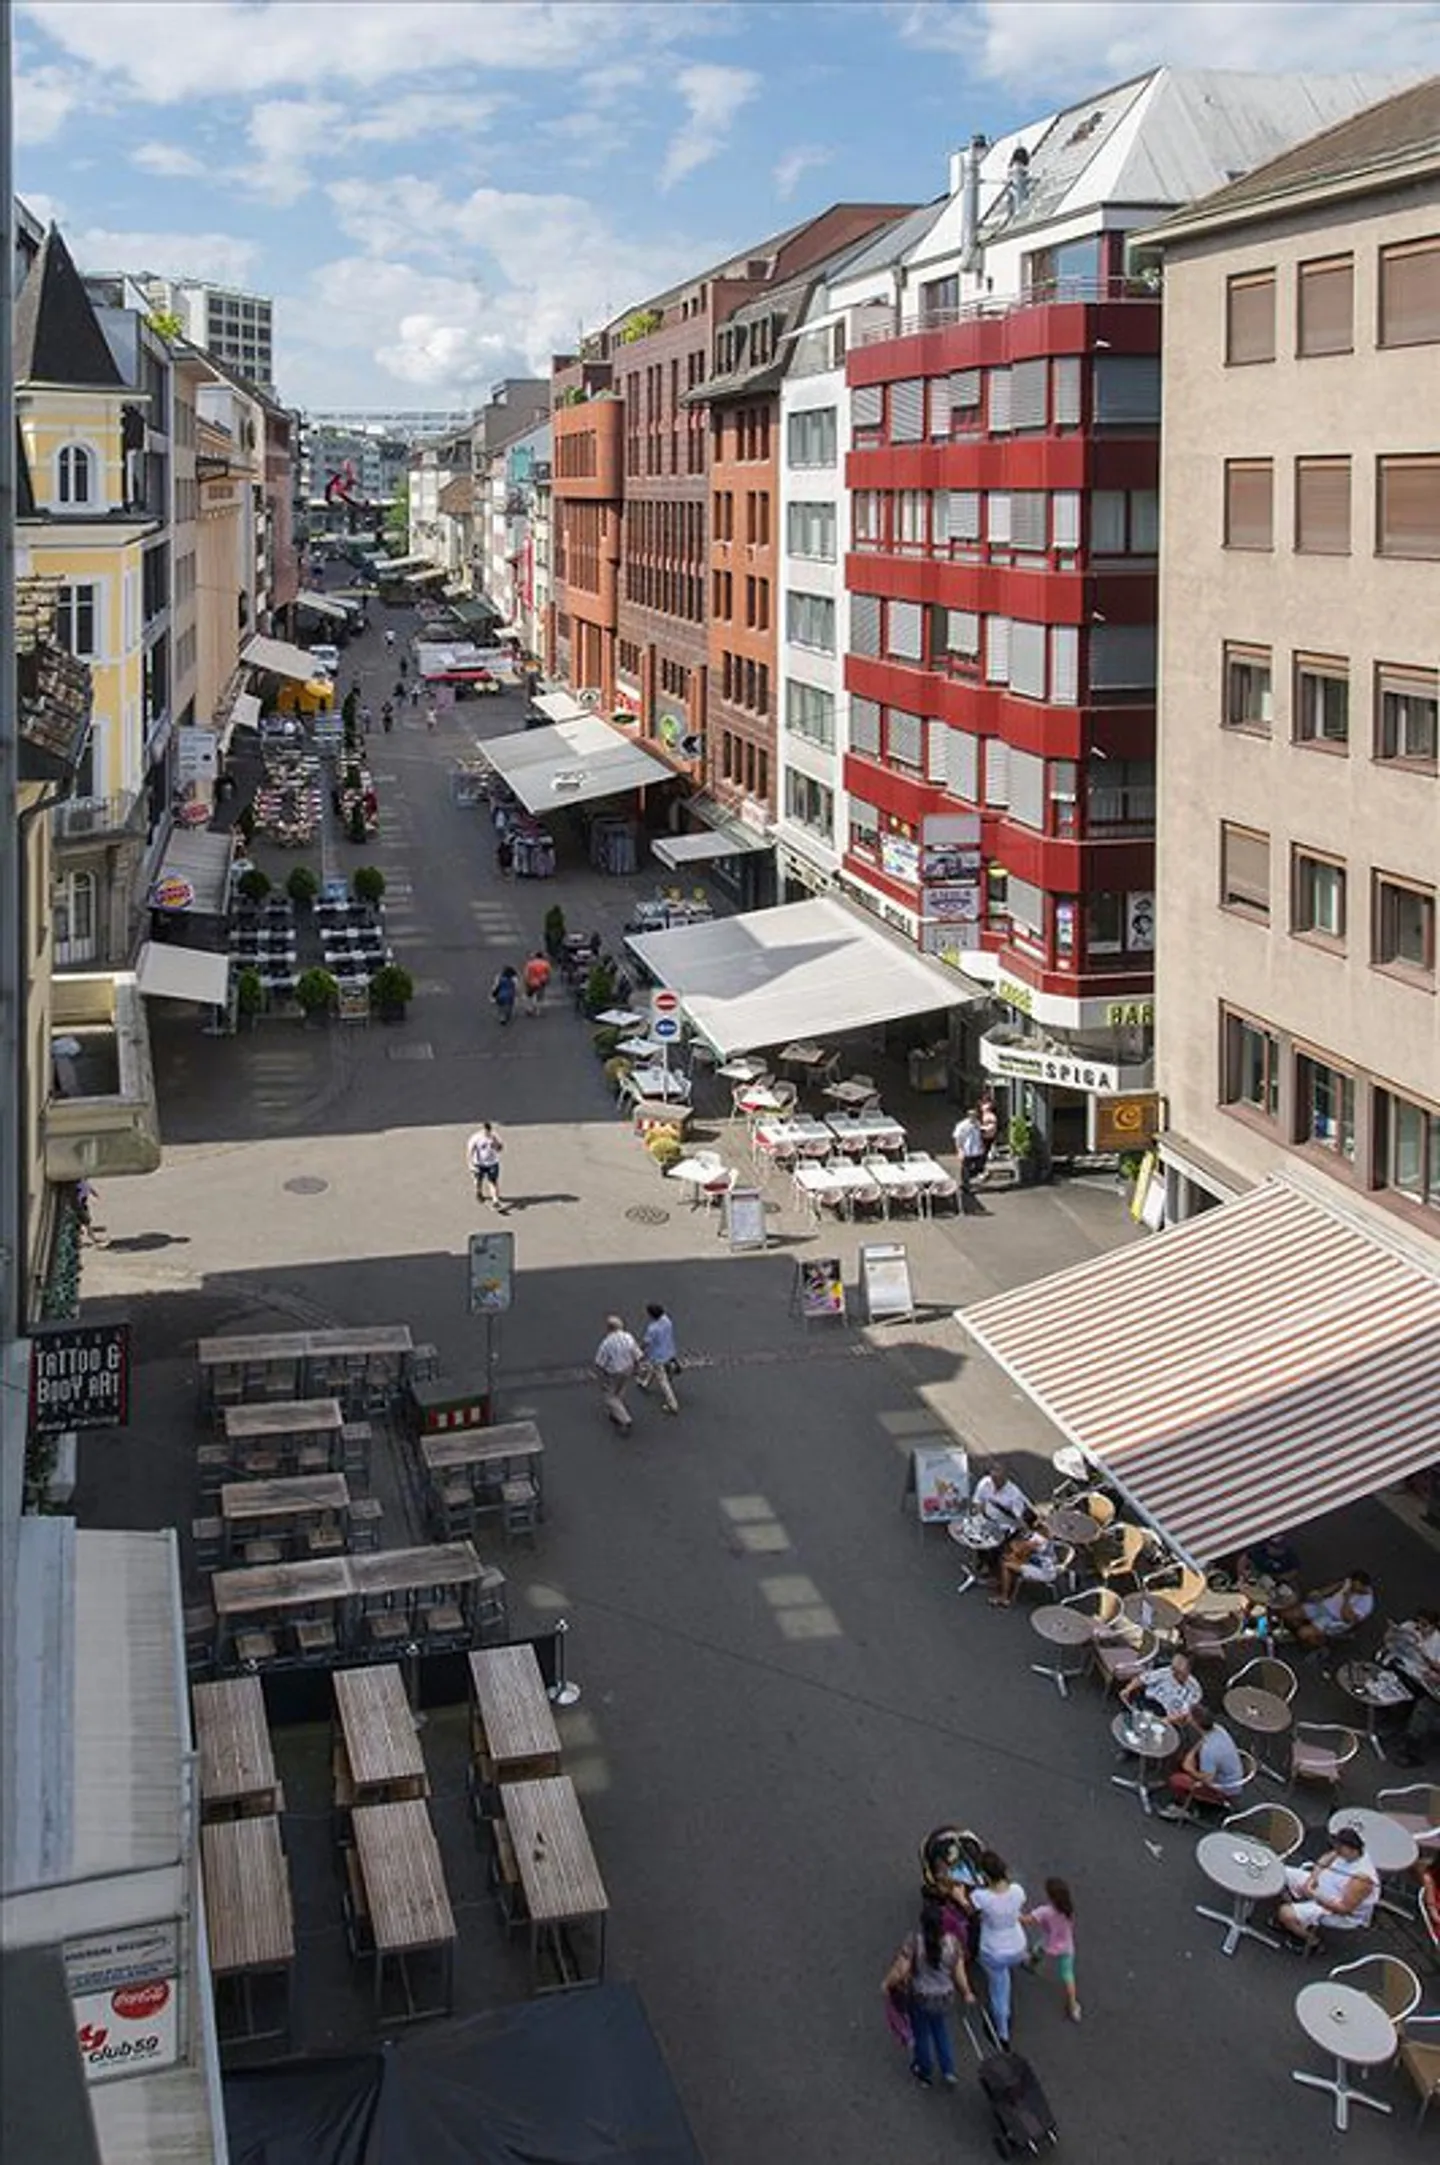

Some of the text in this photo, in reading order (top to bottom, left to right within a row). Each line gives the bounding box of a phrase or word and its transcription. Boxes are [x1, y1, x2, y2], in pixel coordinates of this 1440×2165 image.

[1107, 1003, 1154, 1027] BAR
[1045, 1060, 1110, 1090] SPIGA
[36, 1347, 102, 1377] TATTOO
[37, 1370, 120, 1403] BODY ART
